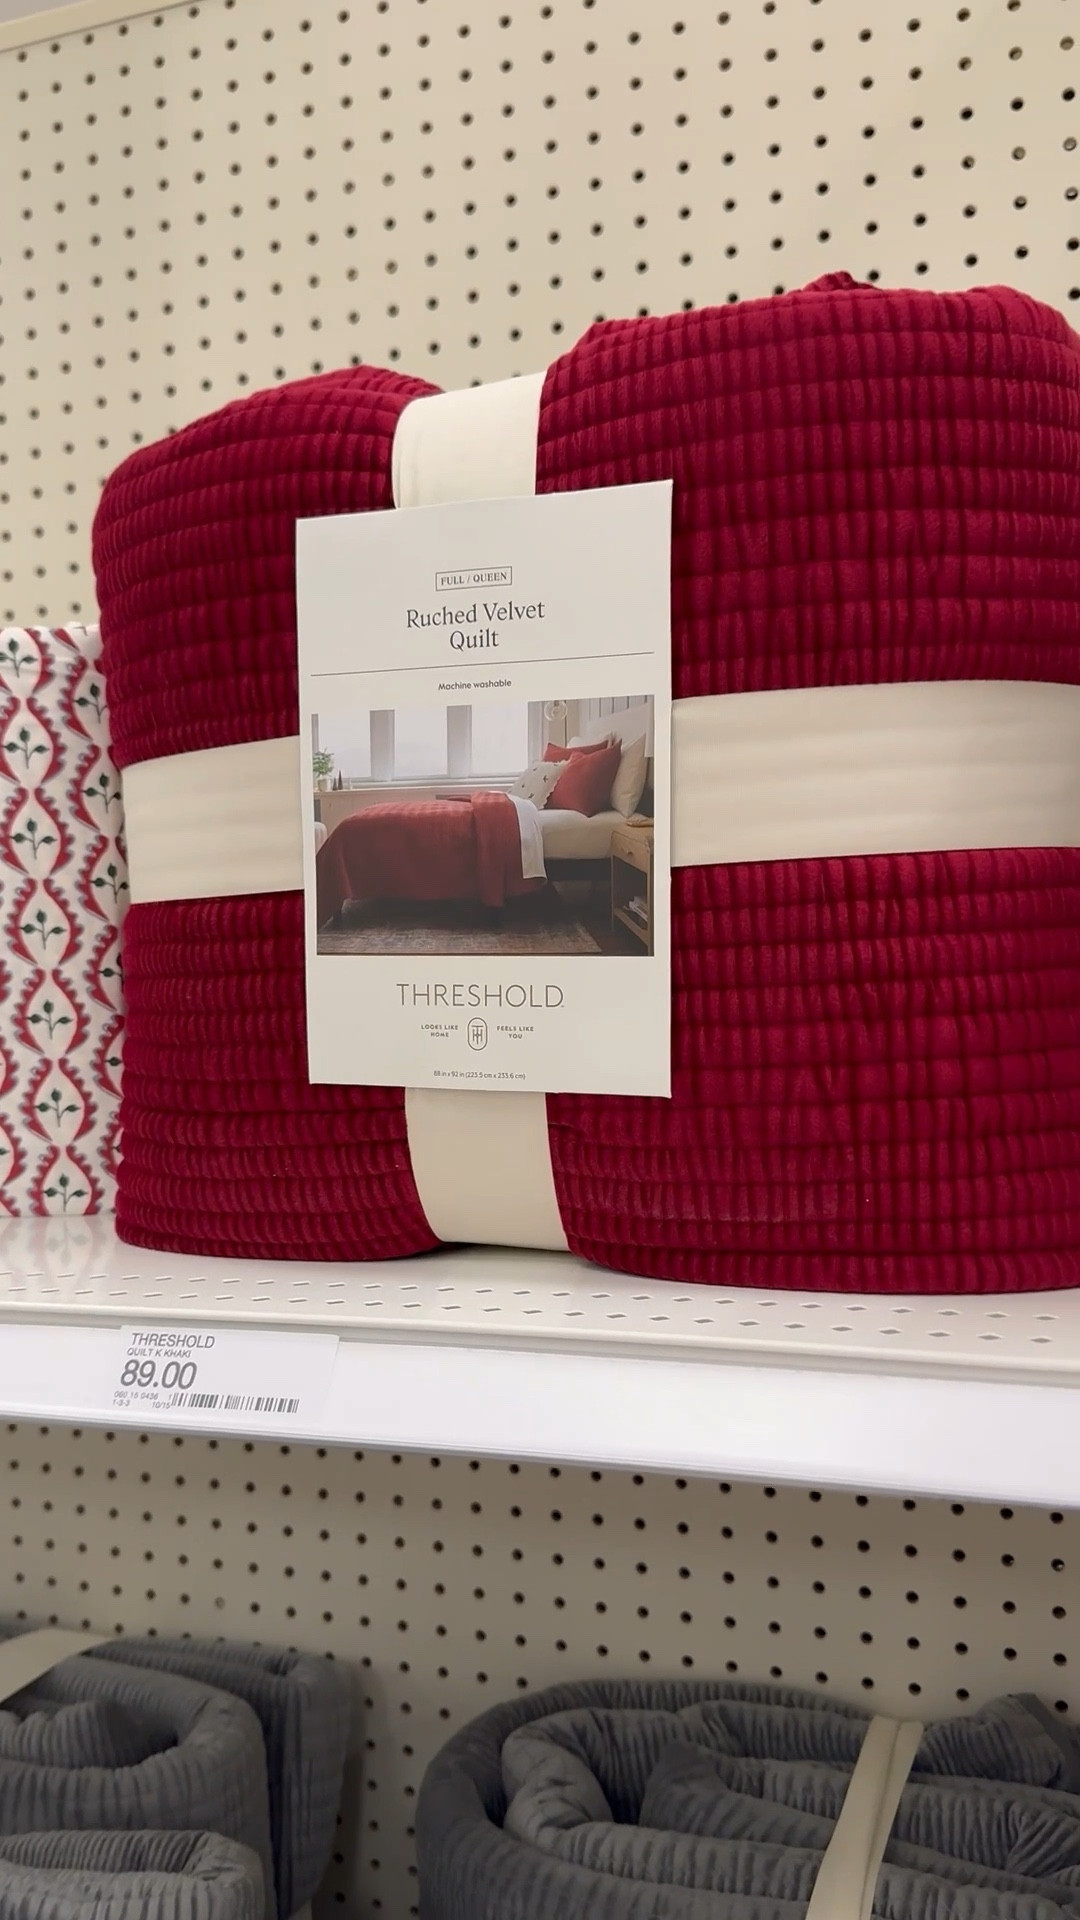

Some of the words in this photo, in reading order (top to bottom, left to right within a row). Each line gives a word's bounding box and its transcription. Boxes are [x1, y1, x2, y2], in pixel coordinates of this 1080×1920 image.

[441, 575, 464, 586] FULL
[473, 572, 507, 582] QUEEN
[407, 603, 477, 628] Ruched
[483, 601, 545, 621] Velvet
[450, 628, 499, 651] Quilt
[438, 682, 471, 691] Machine
[473, 679, 512, 689] washable
[396, 983, 564, 1008] THRESHOLD
[131, 1332, 215, 1349] THRESHOLD
[127, 1348, 153, 1357] QUILT
[155, 1349, 162, 1357] K
[163, 1349, 191, 1358] KHAKI
[120, 1359, 198, 1390] 89.00
